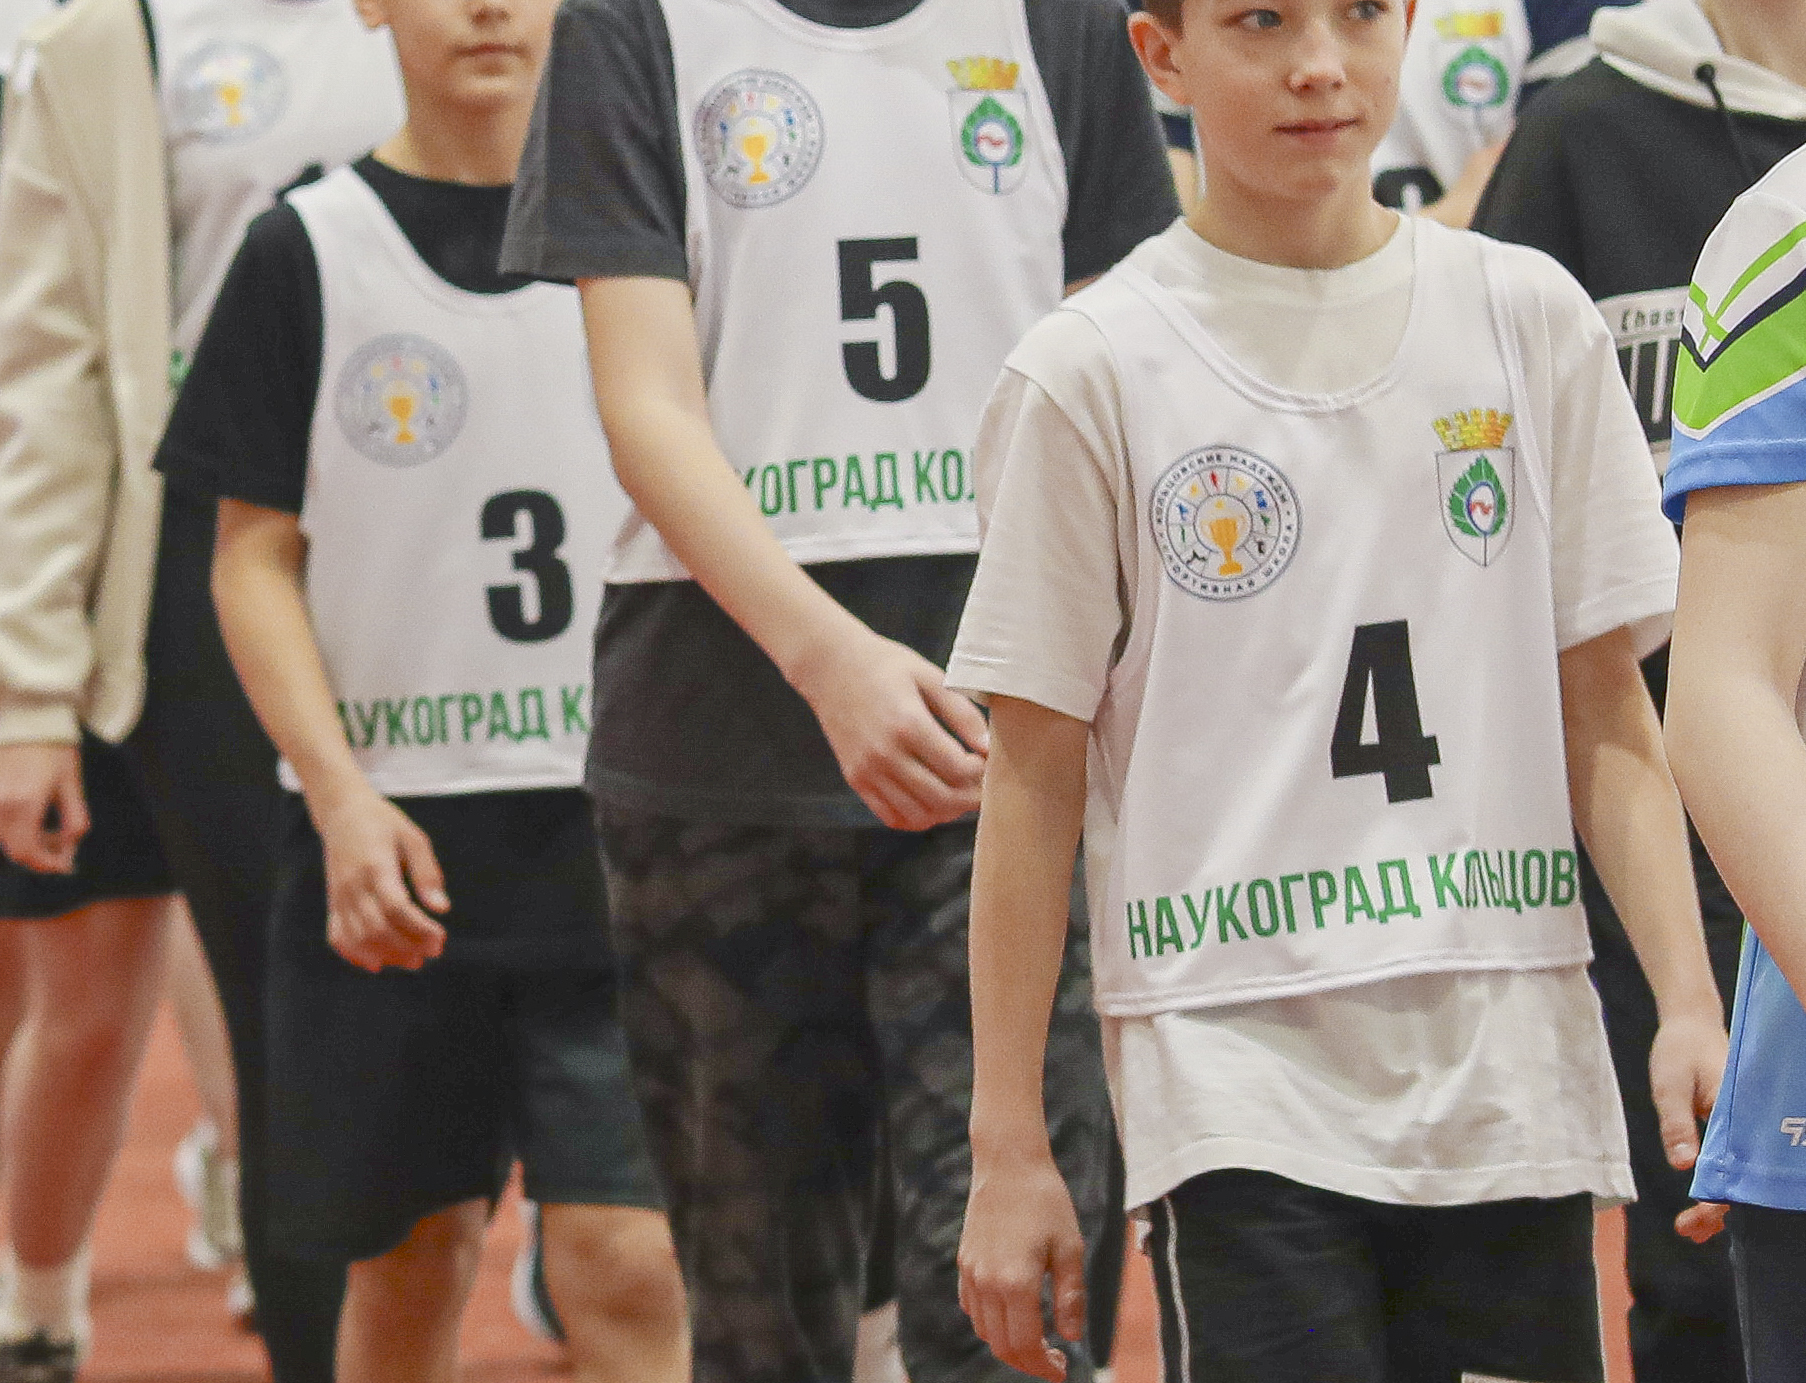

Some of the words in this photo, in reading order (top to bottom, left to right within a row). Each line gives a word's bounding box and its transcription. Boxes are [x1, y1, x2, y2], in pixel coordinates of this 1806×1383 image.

[837, 236, 932, 403] 5
[480, 488, 575, 643] 3
[1330, 619, 1441, 804] 4
[1126, 859, 1422, 960] НАУКОГРАД
